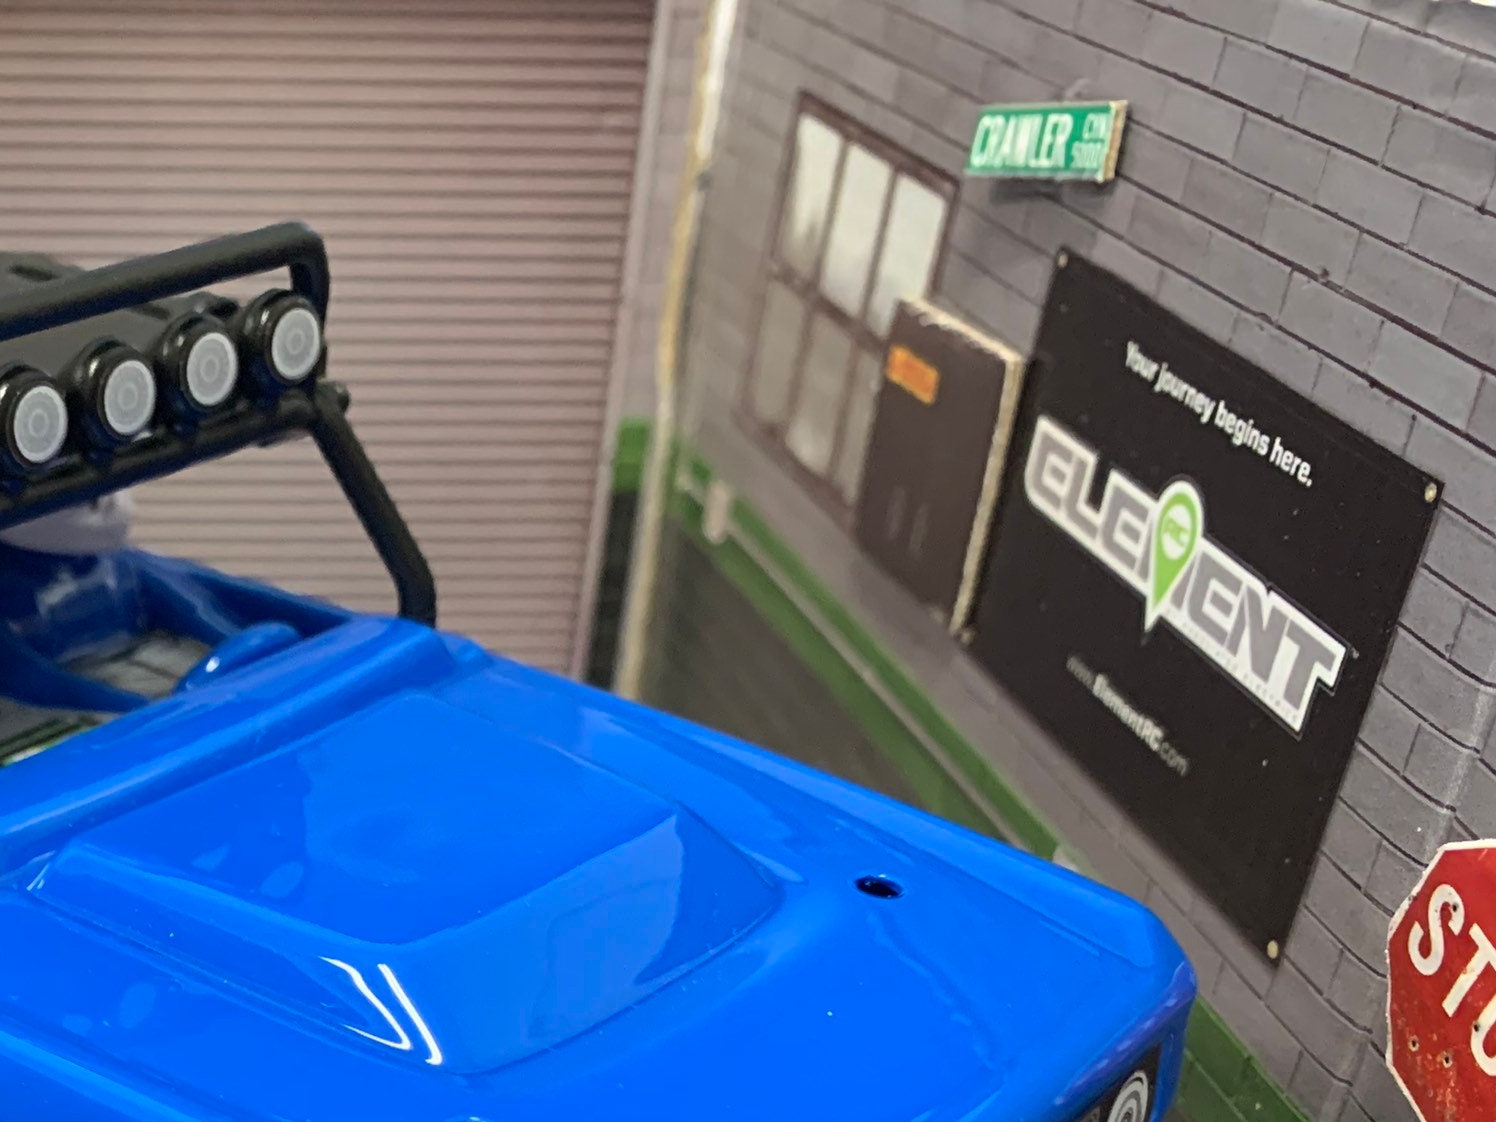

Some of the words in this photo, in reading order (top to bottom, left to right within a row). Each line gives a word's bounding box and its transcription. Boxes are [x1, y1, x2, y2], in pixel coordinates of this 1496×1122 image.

[970, 112, 1074, 169] CRAWLER
[1125, 341, 1160, 382] Your
[1154, 362, 1217, 424] journey
[1214, 400, 1271, 456] begins
[1269, 436, 1313, 487] here.
